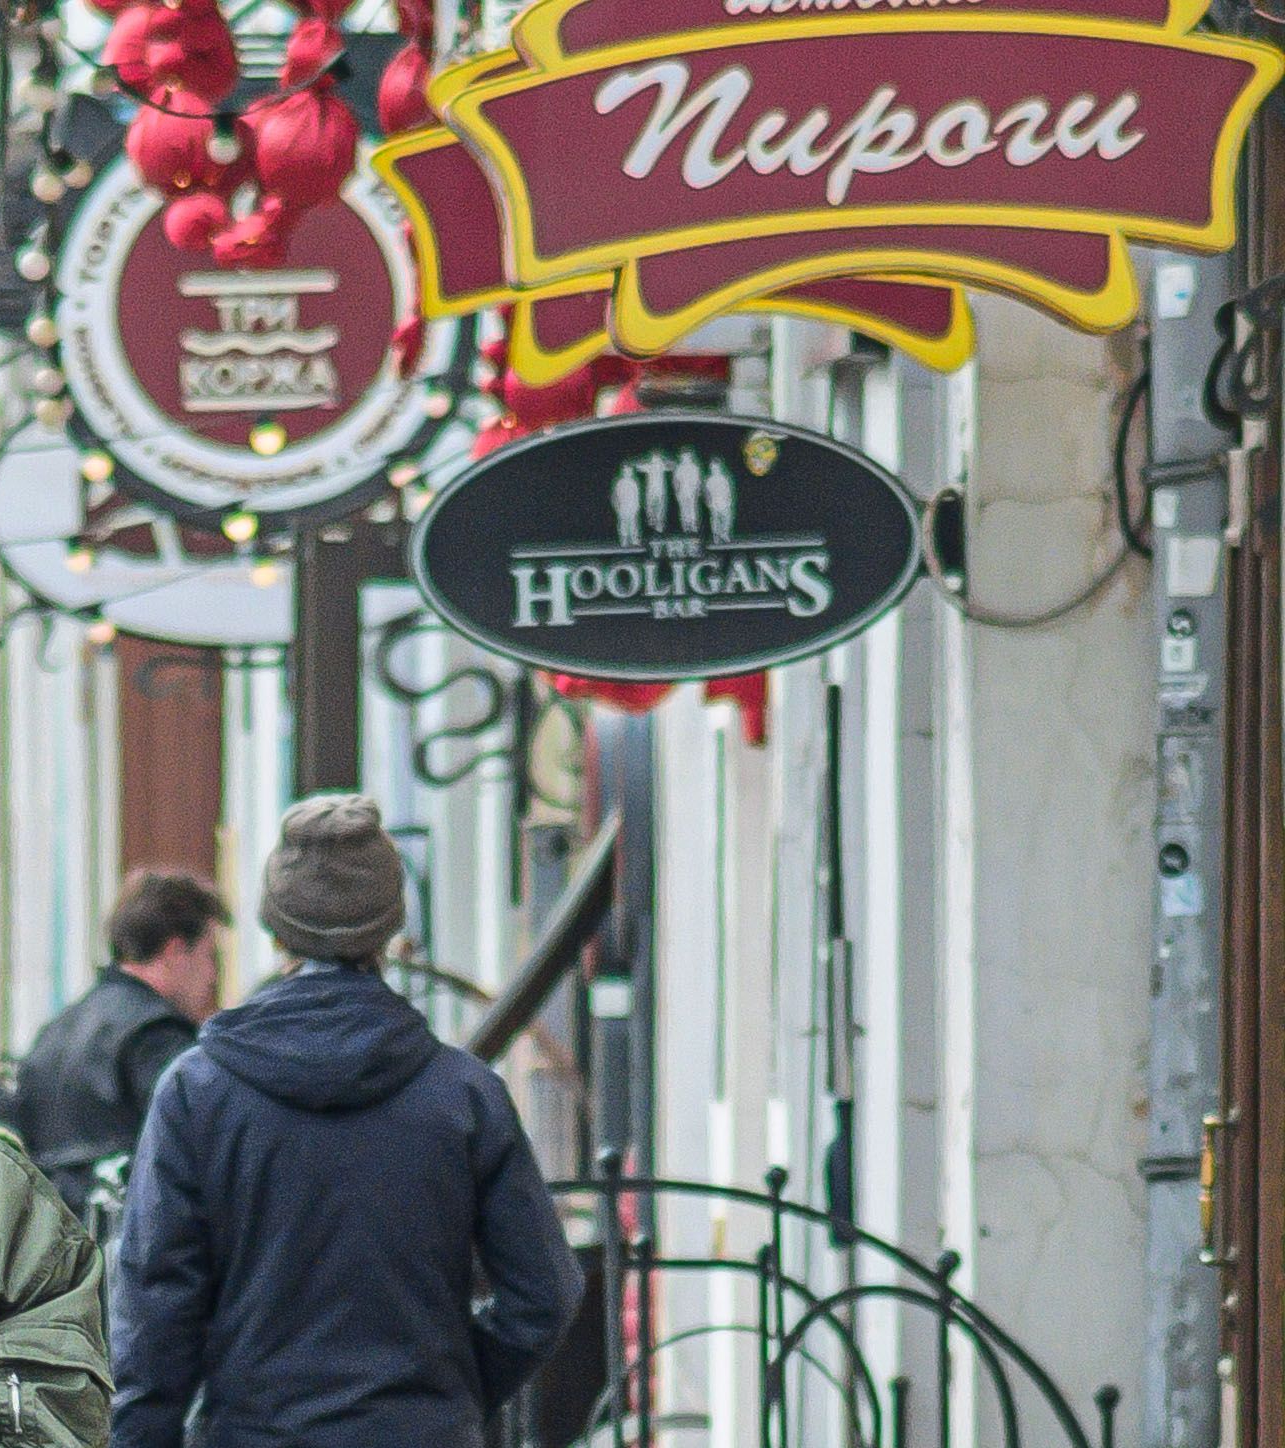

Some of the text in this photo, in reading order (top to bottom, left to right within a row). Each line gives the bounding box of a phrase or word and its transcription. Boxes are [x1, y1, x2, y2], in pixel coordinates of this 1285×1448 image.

[594, 60, 1147, 206] Пироги
[213, 293, 298, 333] ТРИ
[178, 356, 339, 400] КОРЖА
[510, 554, 834, 628] HOOLIGANS
